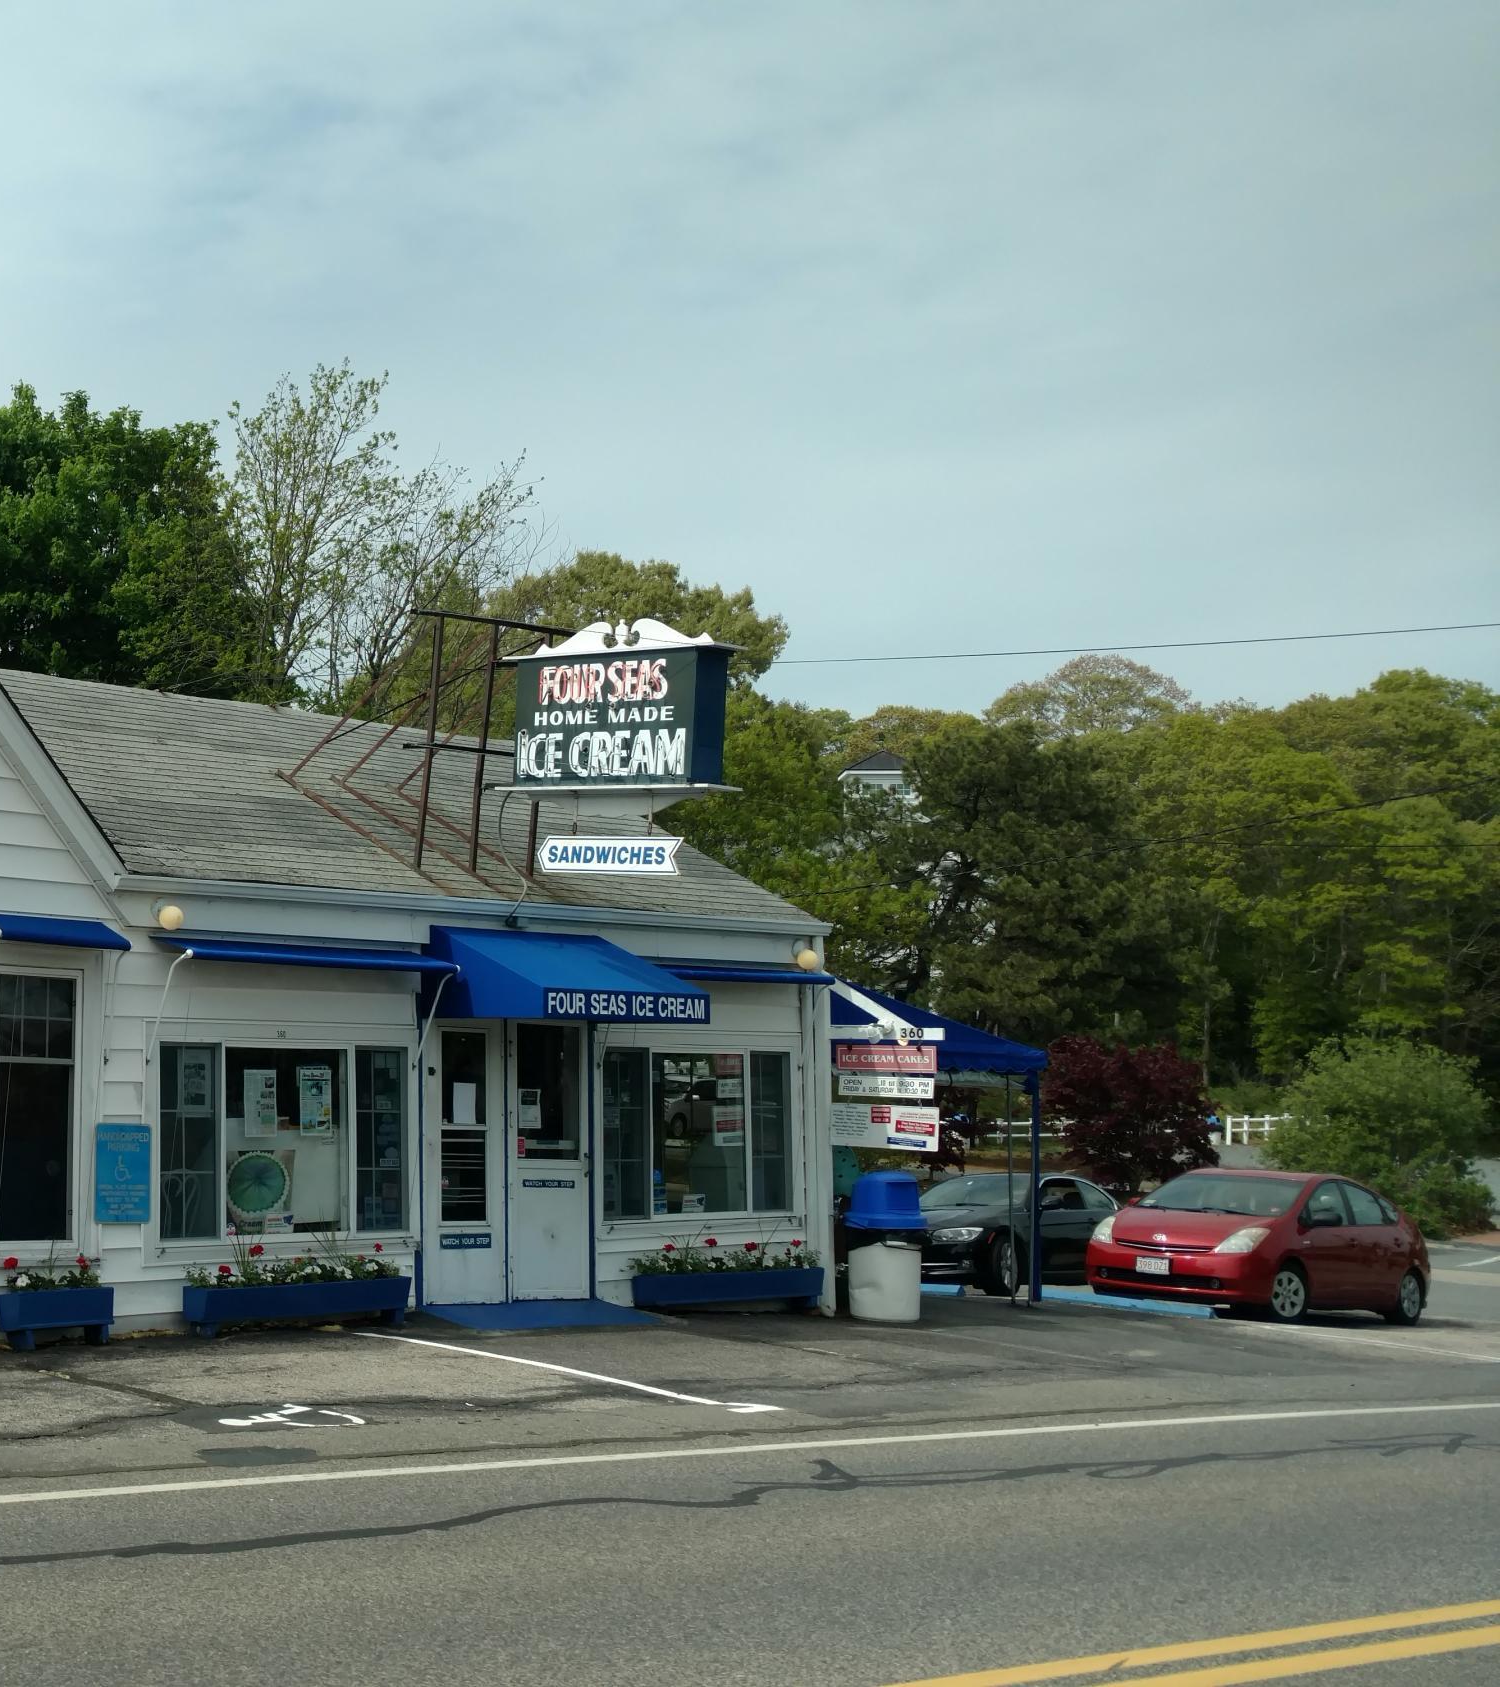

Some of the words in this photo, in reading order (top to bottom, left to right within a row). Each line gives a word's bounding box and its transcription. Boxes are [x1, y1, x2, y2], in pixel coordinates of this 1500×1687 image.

[538, 663, 605, 706] FOUR
[607, 658, 668, 702] SEAS
[534, 709, 598, 726] HOME
[608, 706, 674, 723] MADE
[517, 731, 564, 778] ICE
[569, 728, 687, 778] CREAM
[548, 845, 666, 865] SANDWICHES
[547, 992, 586, 1015] FOUR
[590, 993, 627, 1016] SEAS
[632, 995, 655, 1017] ICE
[658, 997, 705, 1020] CREAM
[900, 1028, 924, 1039] 360
[842, 1054, 858, 1062] ICE
[861, 1055, 894, 1063] CREAM
[897, 1056, 930, 1064] CAKES
